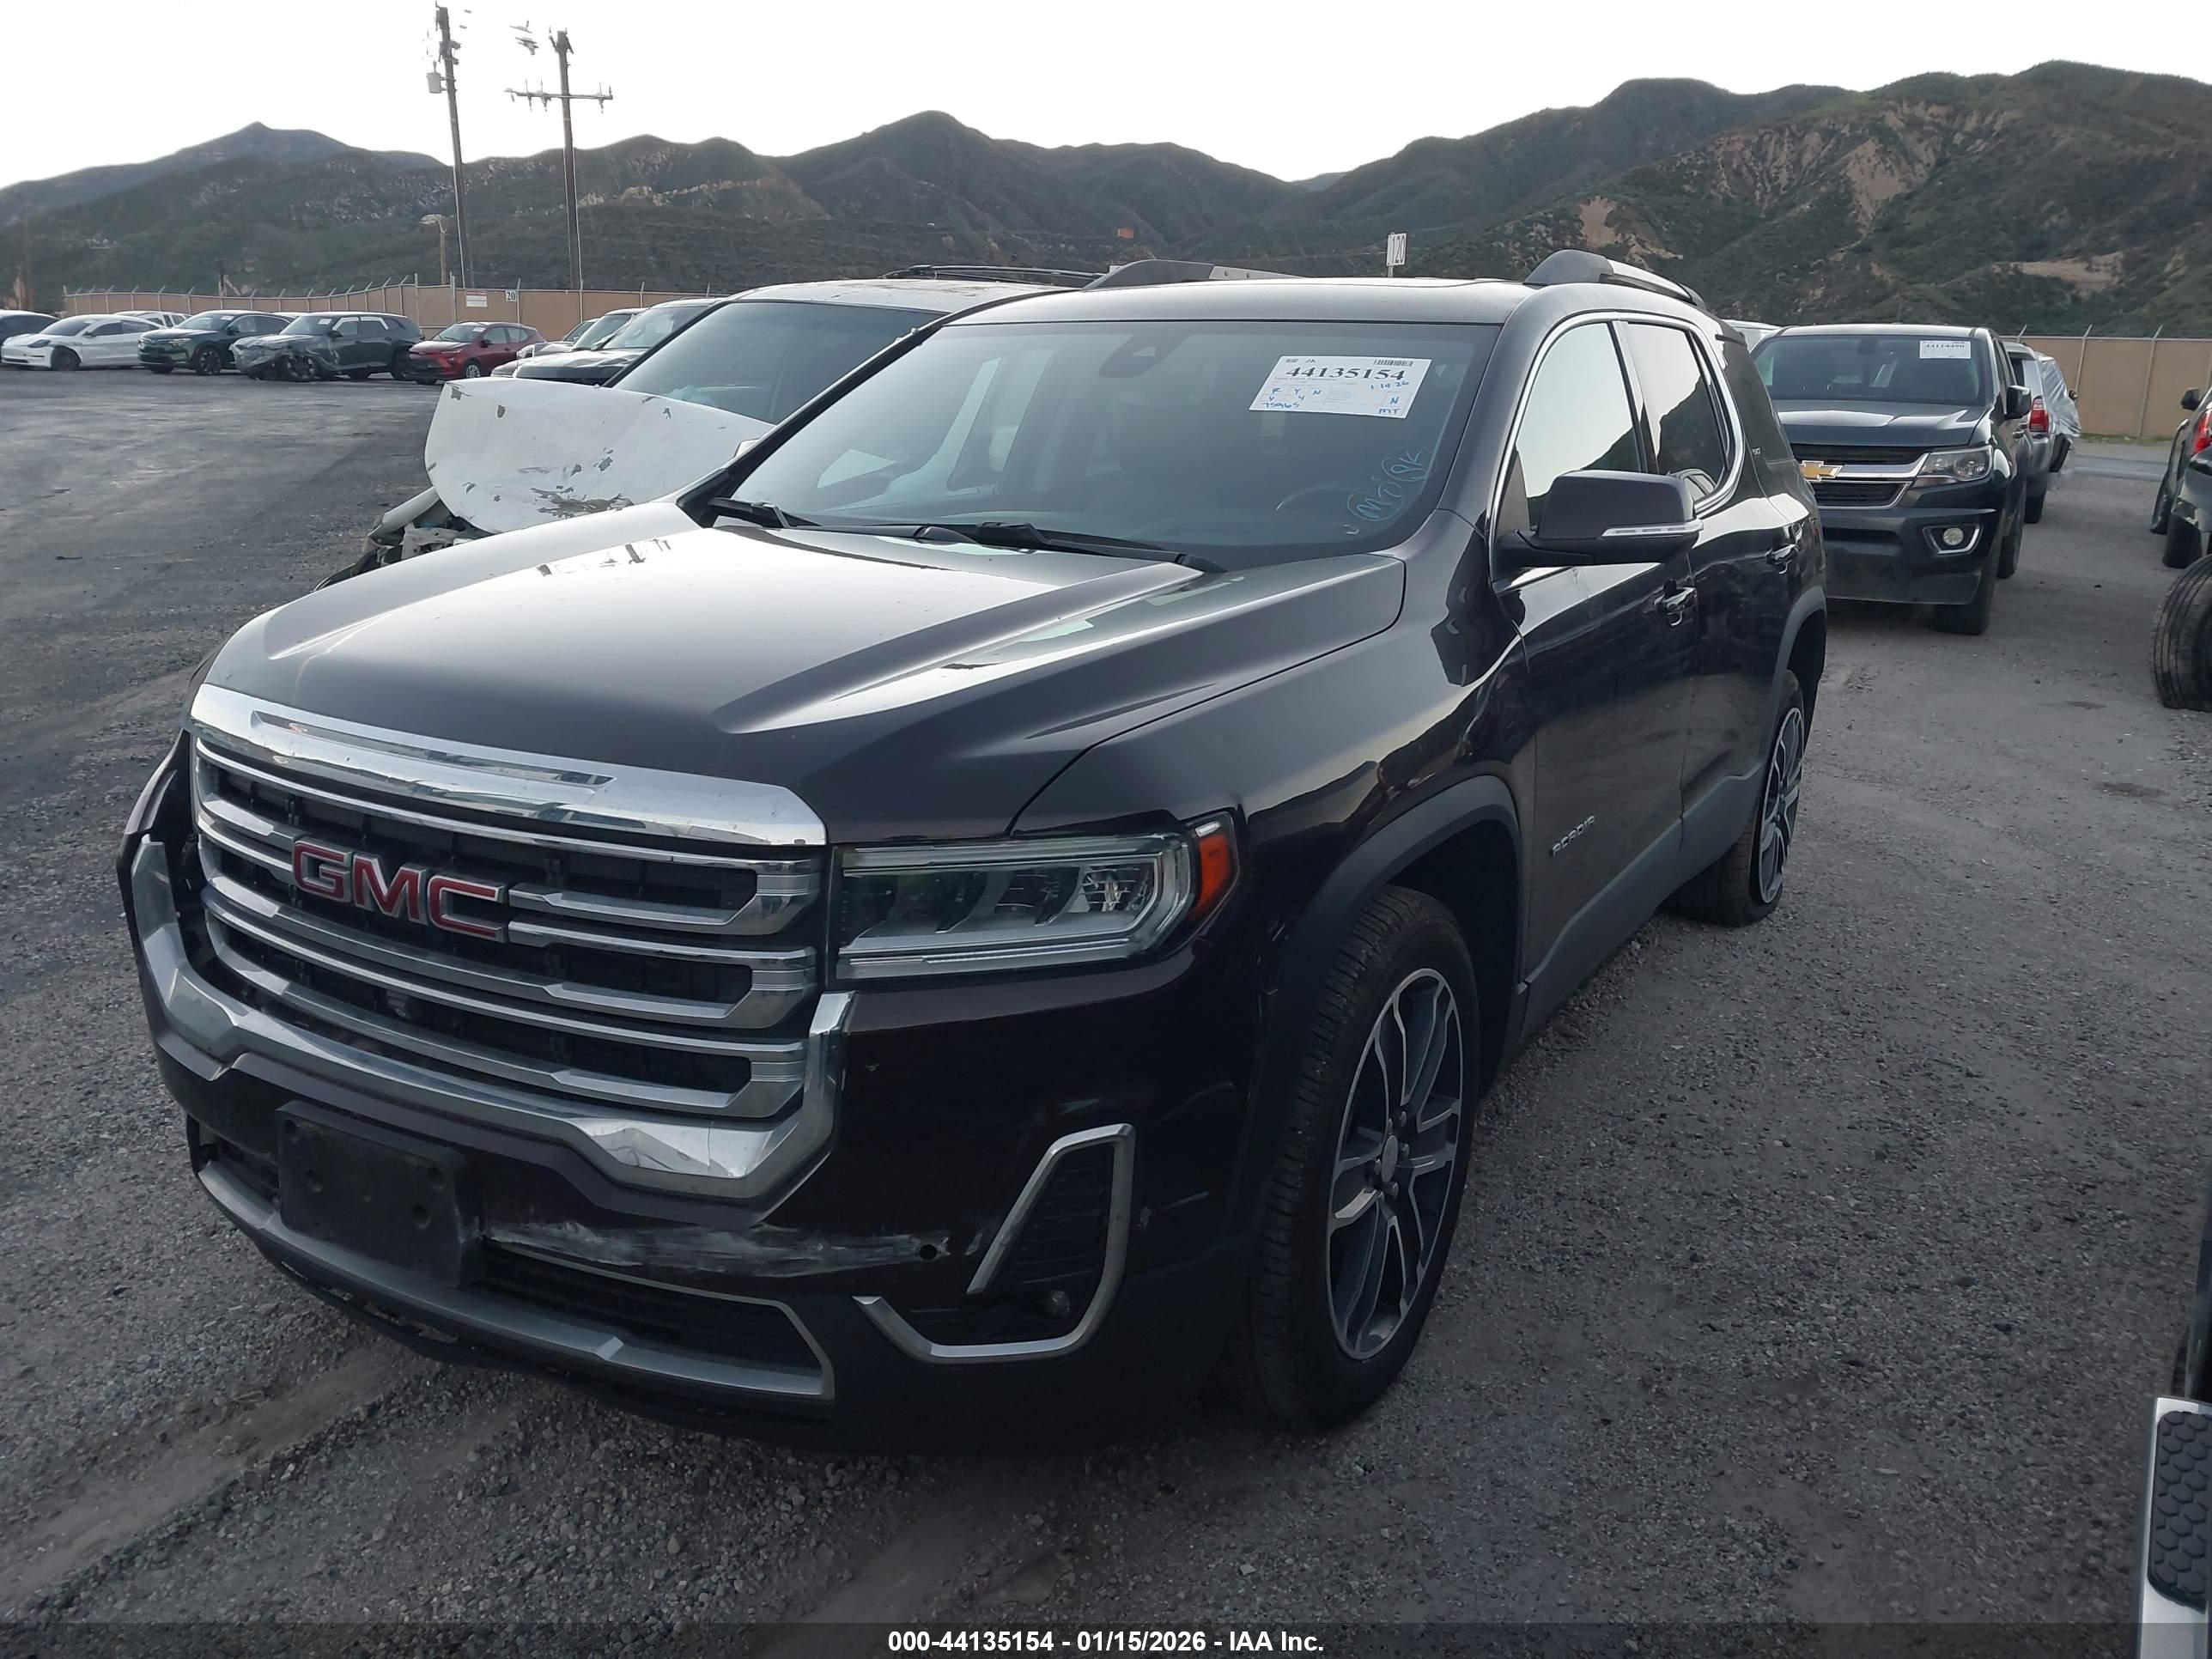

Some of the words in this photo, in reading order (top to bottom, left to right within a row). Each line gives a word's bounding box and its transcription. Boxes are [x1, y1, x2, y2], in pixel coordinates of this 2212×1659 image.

[506, 291, 516, 301] 20
[1286, 367, 1406, 380] 44135154
[1389, 396, 1400, 404] N
[1553, 815, 1595, 857] ACADIA
[292, 840, 508, 943] GMC
